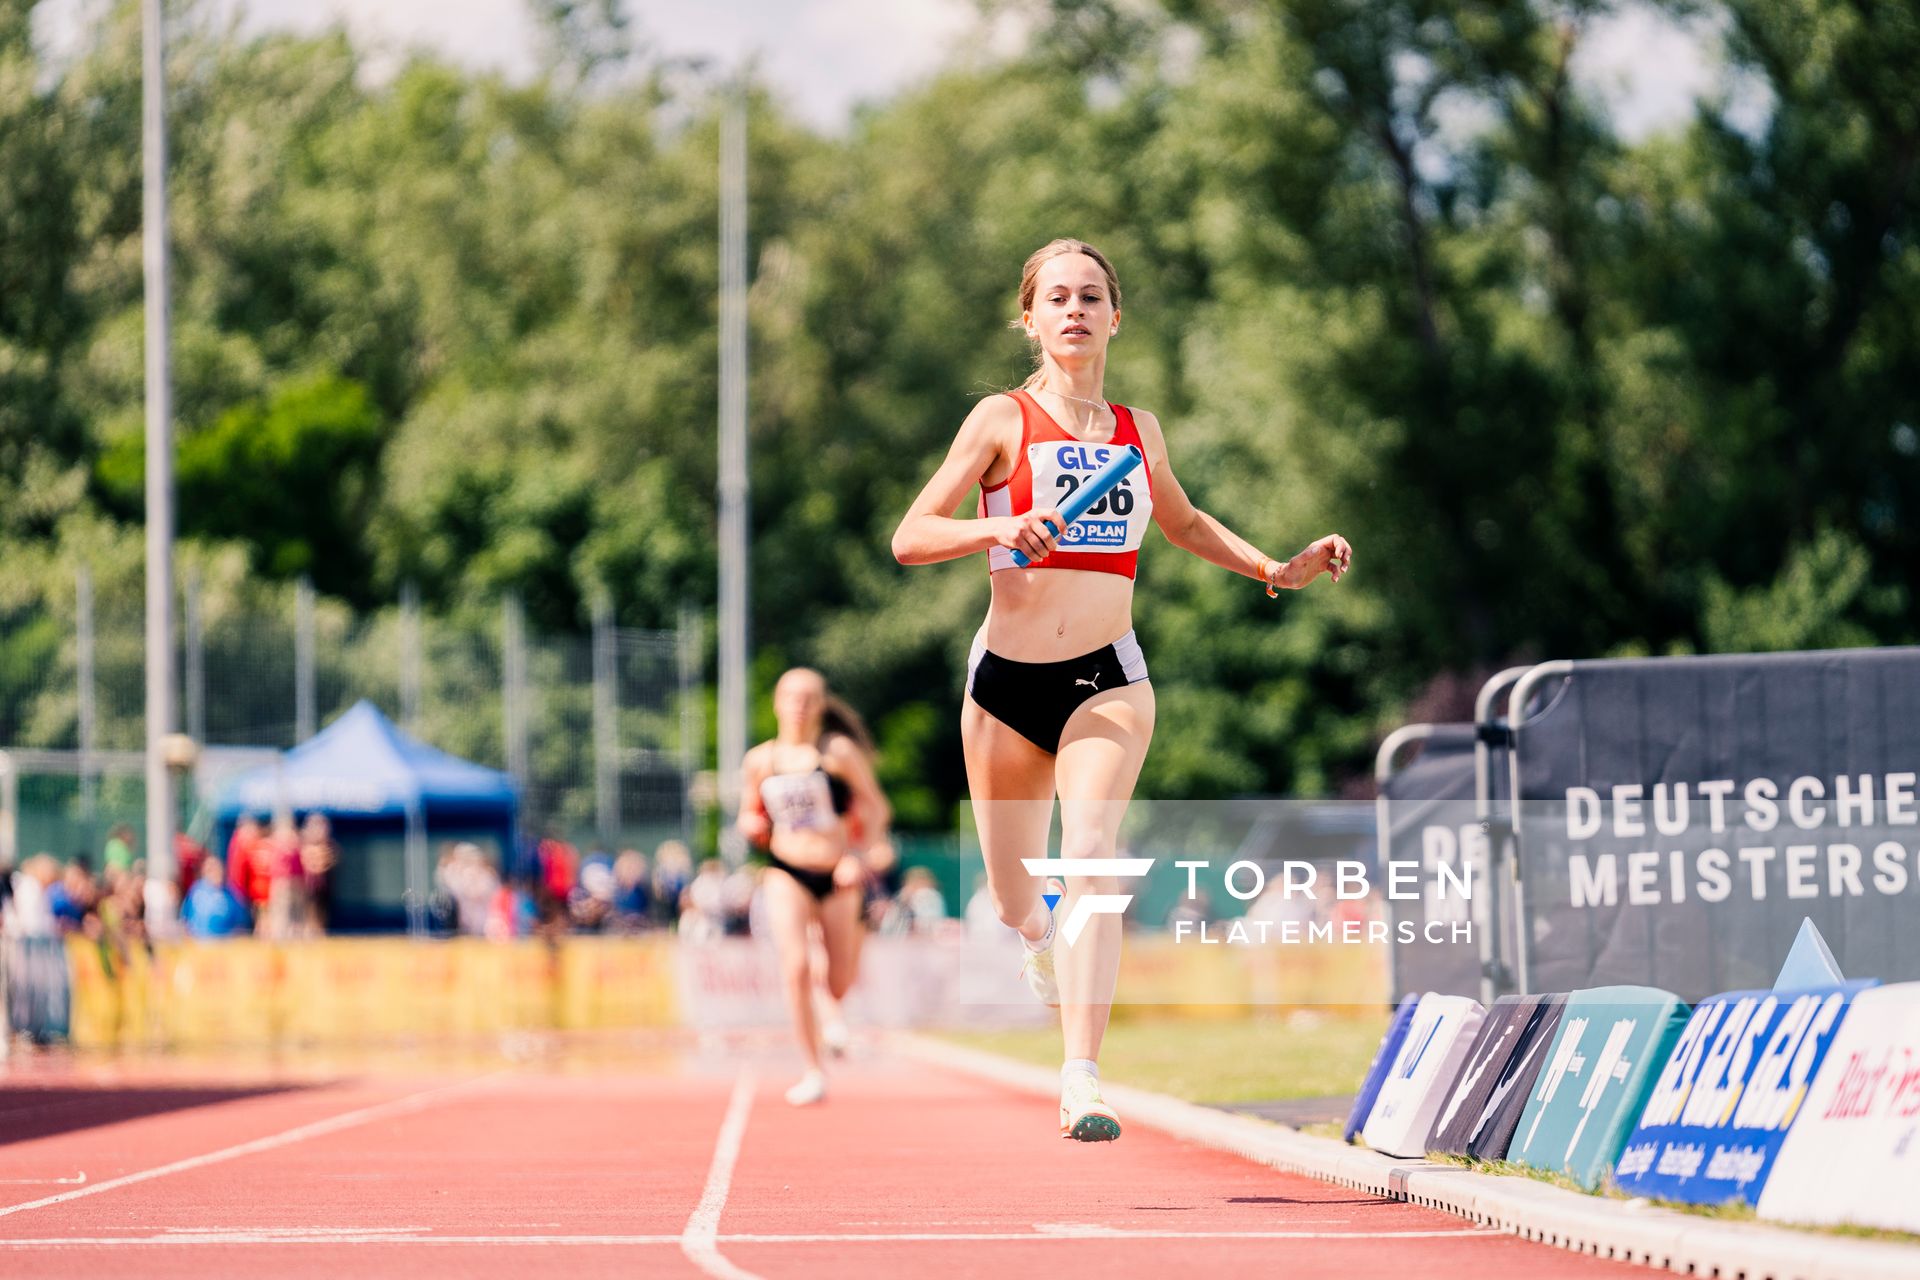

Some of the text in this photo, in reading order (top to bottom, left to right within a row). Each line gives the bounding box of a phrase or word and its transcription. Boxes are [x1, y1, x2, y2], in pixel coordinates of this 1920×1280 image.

[1056, 446, 1110, 470] GLS
[1087, 524, 1125, 537] PLAN
[1565, 772, 1918, 840] DEUTSCHE
[1568, 841, 1920, 908] MEISTERS
